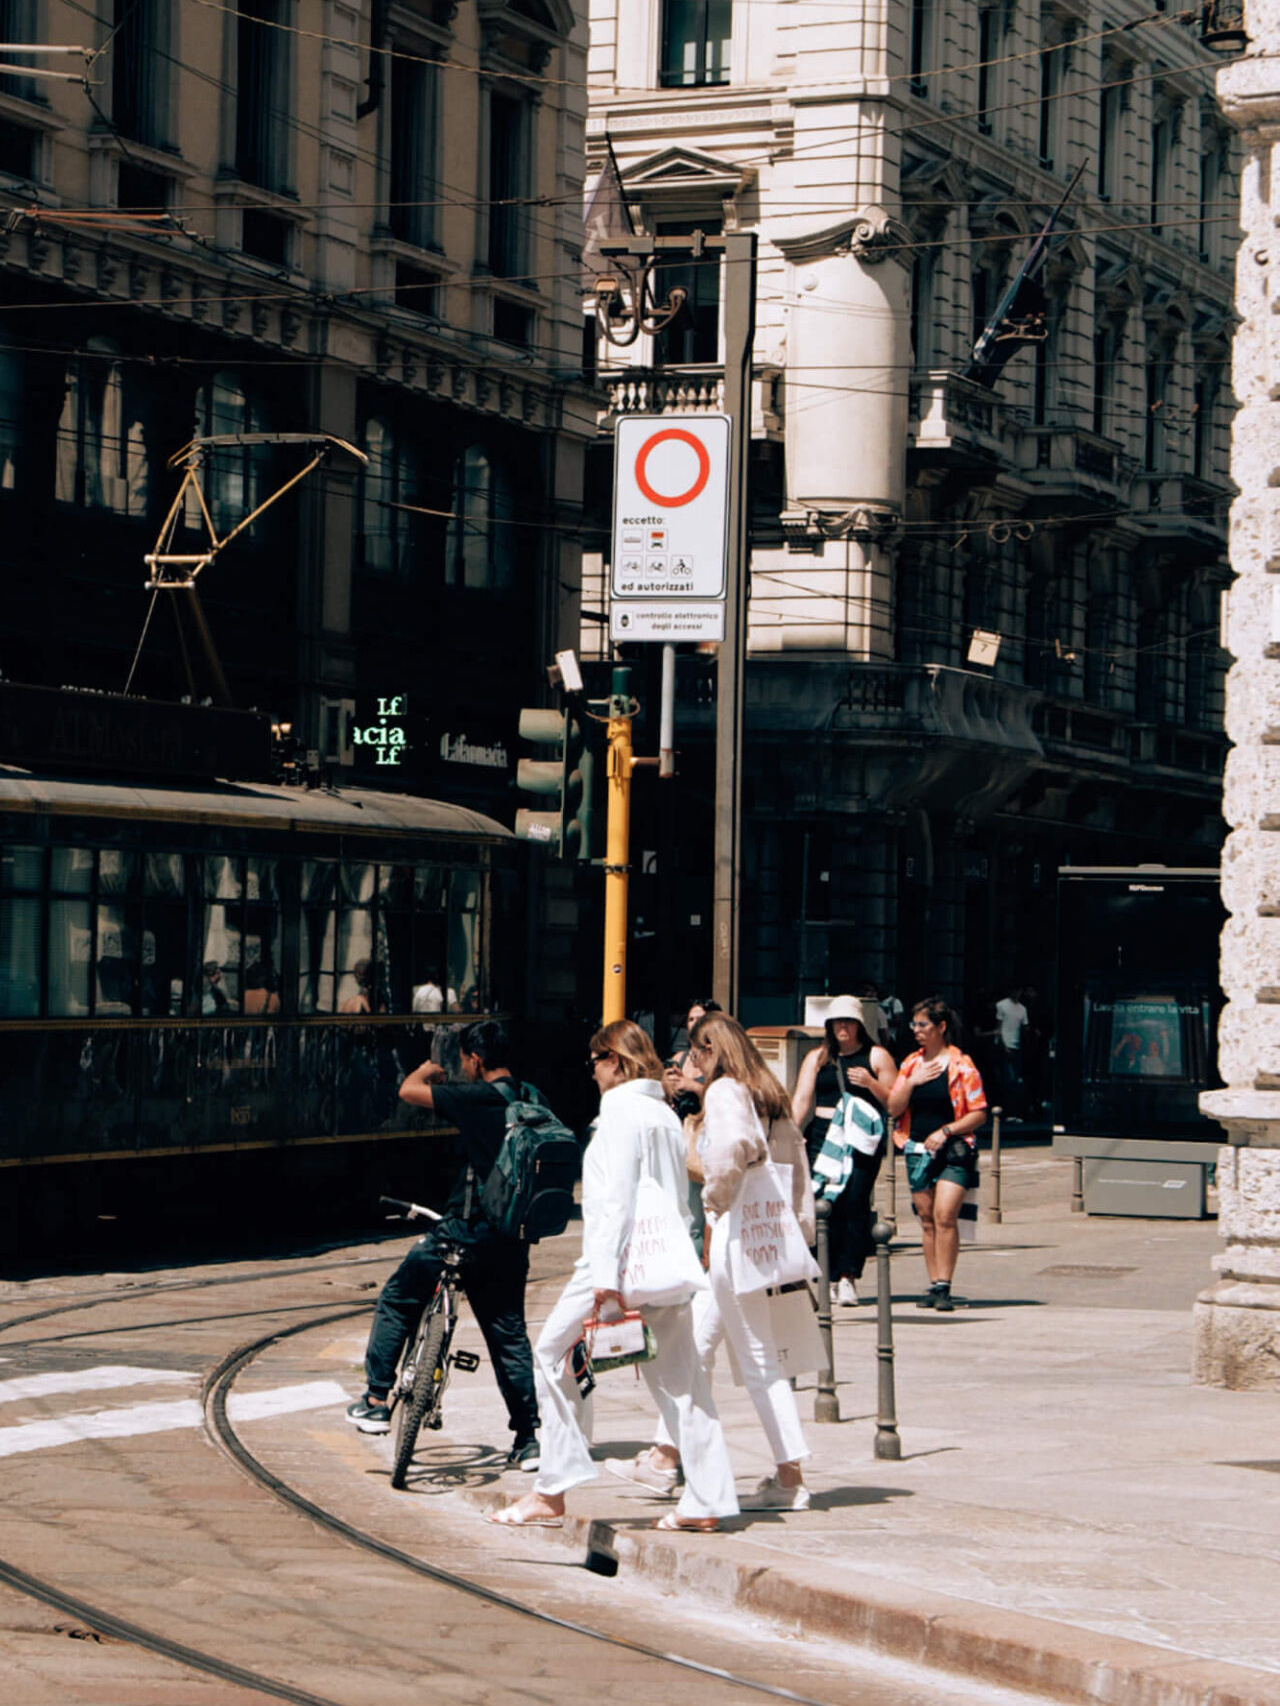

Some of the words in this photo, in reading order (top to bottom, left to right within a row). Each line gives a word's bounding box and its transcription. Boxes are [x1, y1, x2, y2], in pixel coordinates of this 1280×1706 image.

[622, 516, 665, 525] eccetto:
[621, 582, 634, 591] ed
[637, 582, 694, 591] autorizzati
